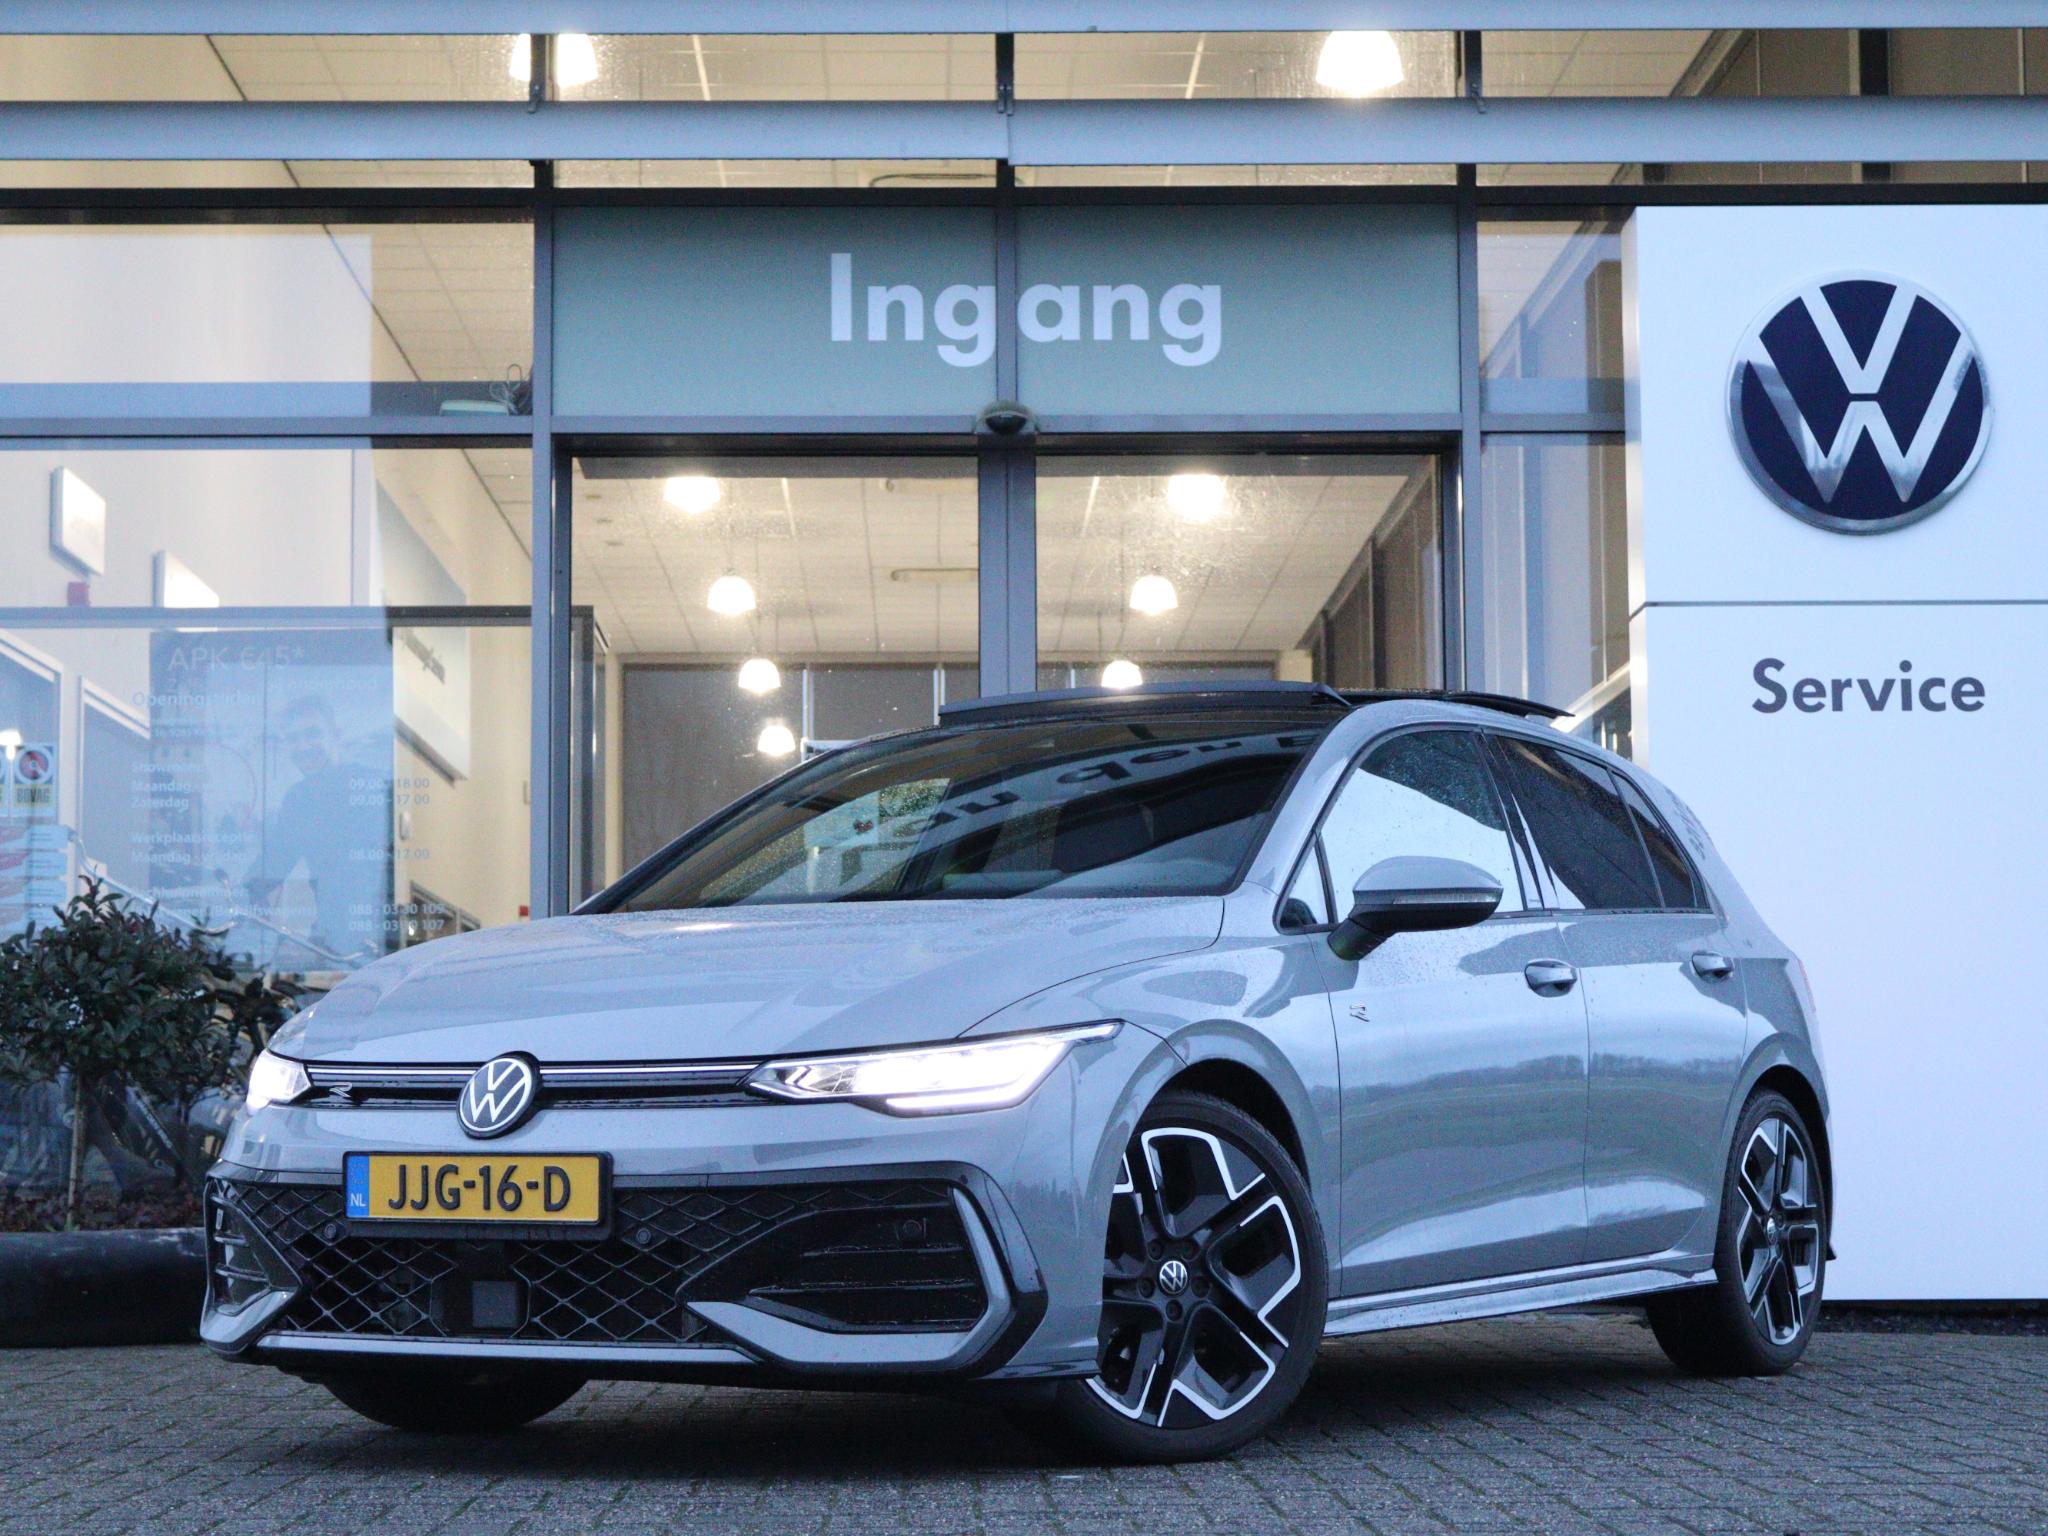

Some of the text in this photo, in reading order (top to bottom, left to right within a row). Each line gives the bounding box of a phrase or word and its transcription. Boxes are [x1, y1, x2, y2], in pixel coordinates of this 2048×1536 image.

[830, 252, 1222, 367] Ingang
[168, 647, 229, 670] APK
[1752, 657, 1986, 714] Service
[397, 777, 430, 789] 1800
[17, 788, 50, 803] BOVAG
[131, 797, 190, 813] Zaterdag
[397, 794, 430, 805] 1700
[350, 1163, 572, 1213] NL JJG-16-D
